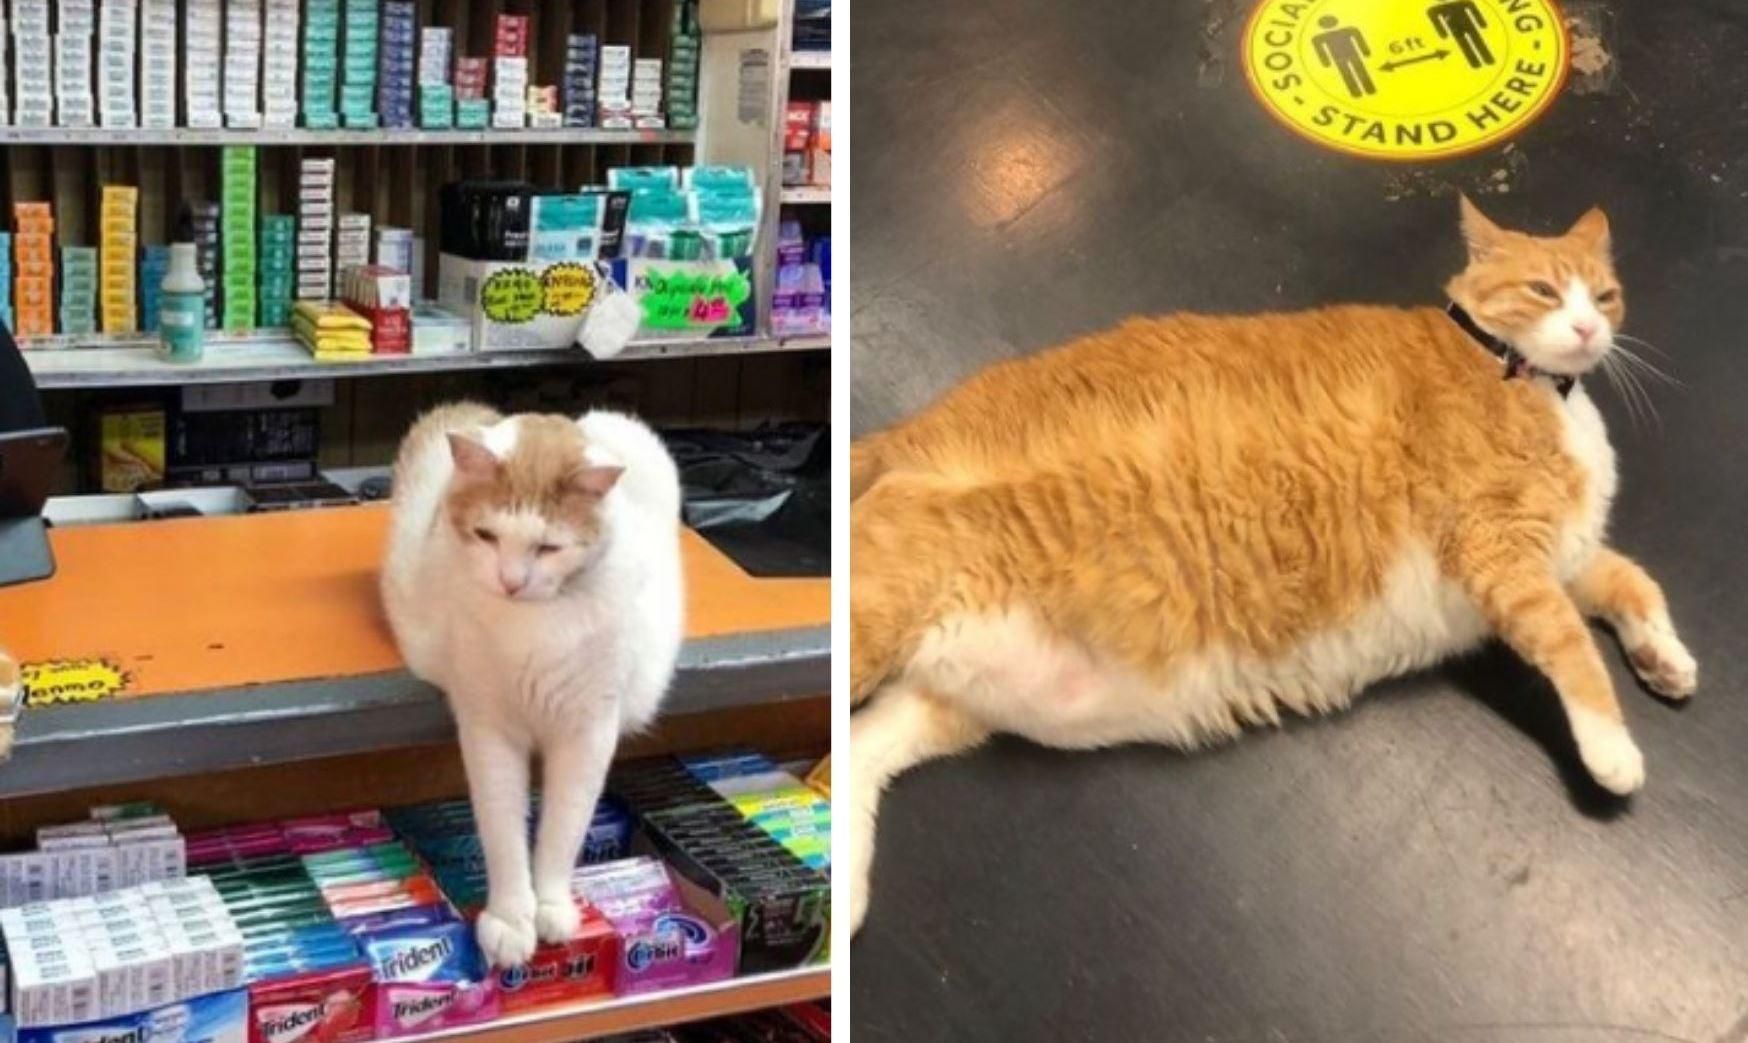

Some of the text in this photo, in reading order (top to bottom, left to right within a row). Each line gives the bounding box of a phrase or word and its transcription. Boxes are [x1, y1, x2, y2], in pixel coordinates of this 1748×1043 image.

[1264, 0, 1315, 91] SOCIA
[1311, 104, 1458, 146] STAND
[1465, 58, 1546, 131] HERE
[380, 937, 450, 979] Trident
[262, 1002, 325, 1039] Trident
[391, 987, 455, 1018] Trident
